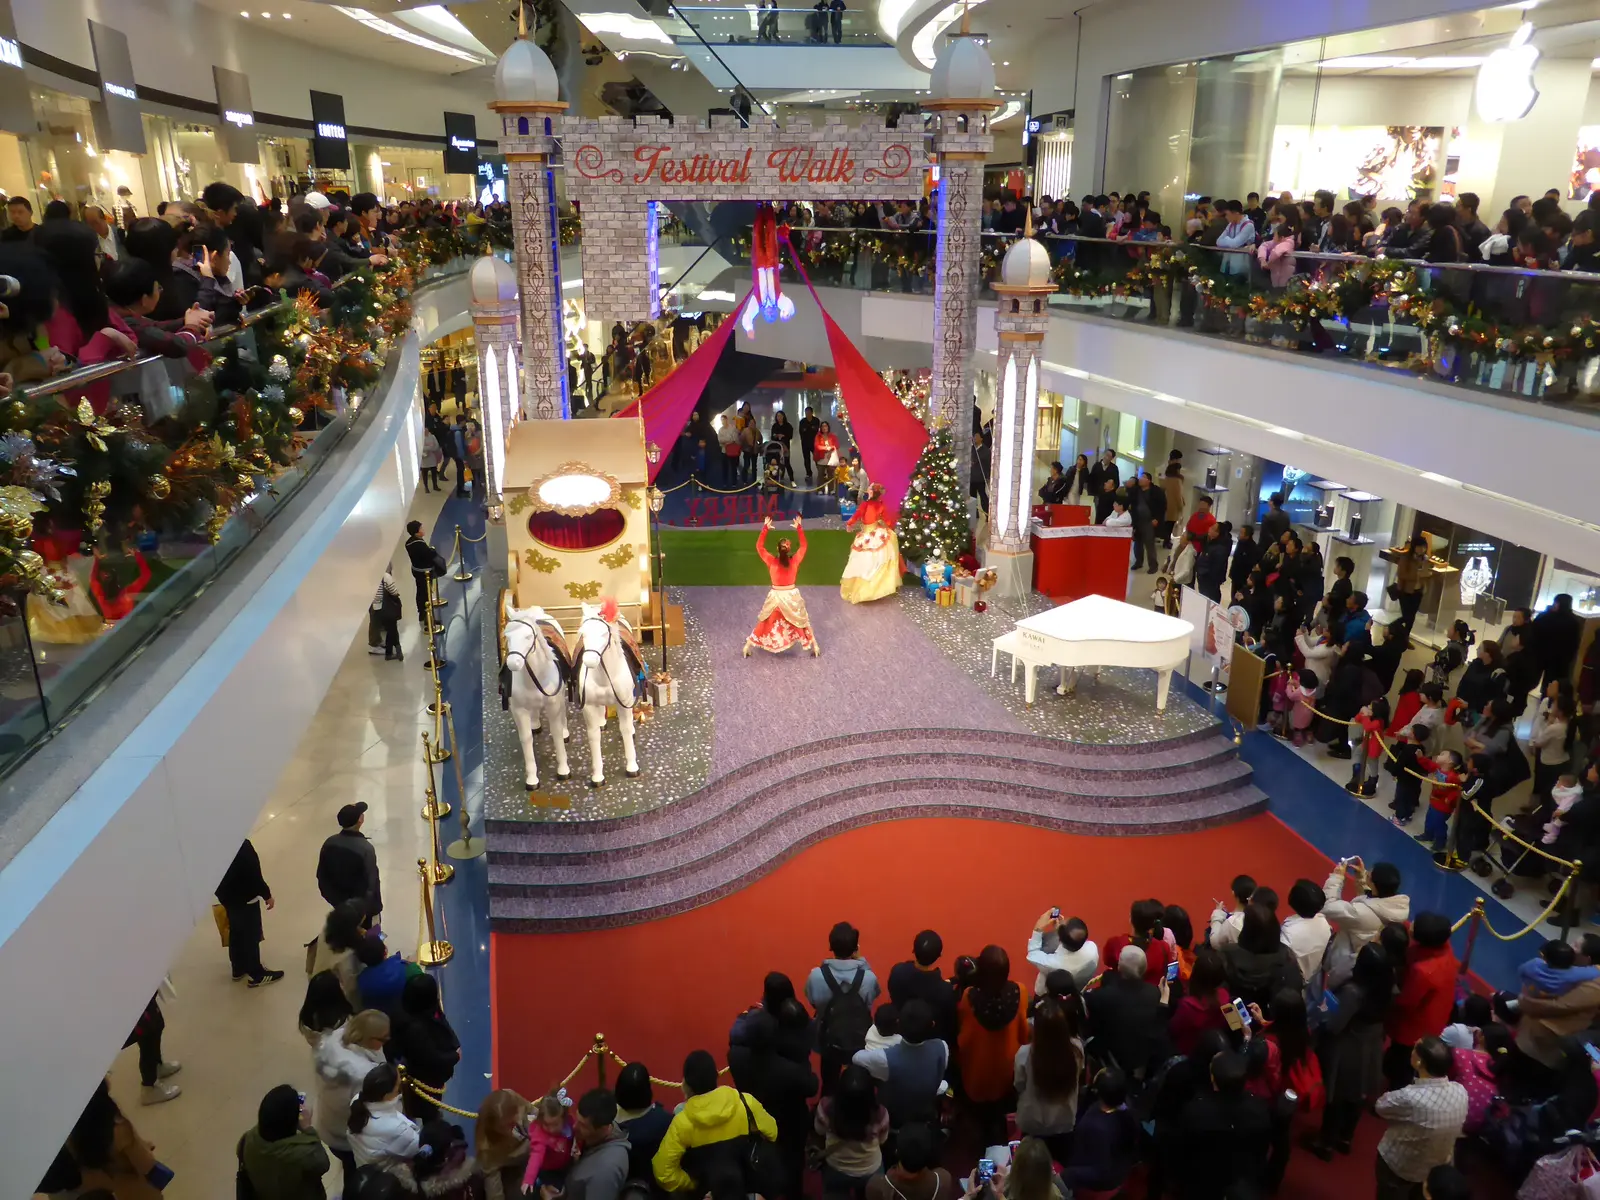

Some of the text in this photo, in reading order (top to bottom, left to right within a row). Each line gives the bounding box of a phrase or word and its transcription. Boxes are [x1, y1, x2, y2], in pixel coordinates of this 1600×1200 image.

[633, 145, 854, 184] Festival Walk
[1022, 631, 1046, 644] KAWAI
